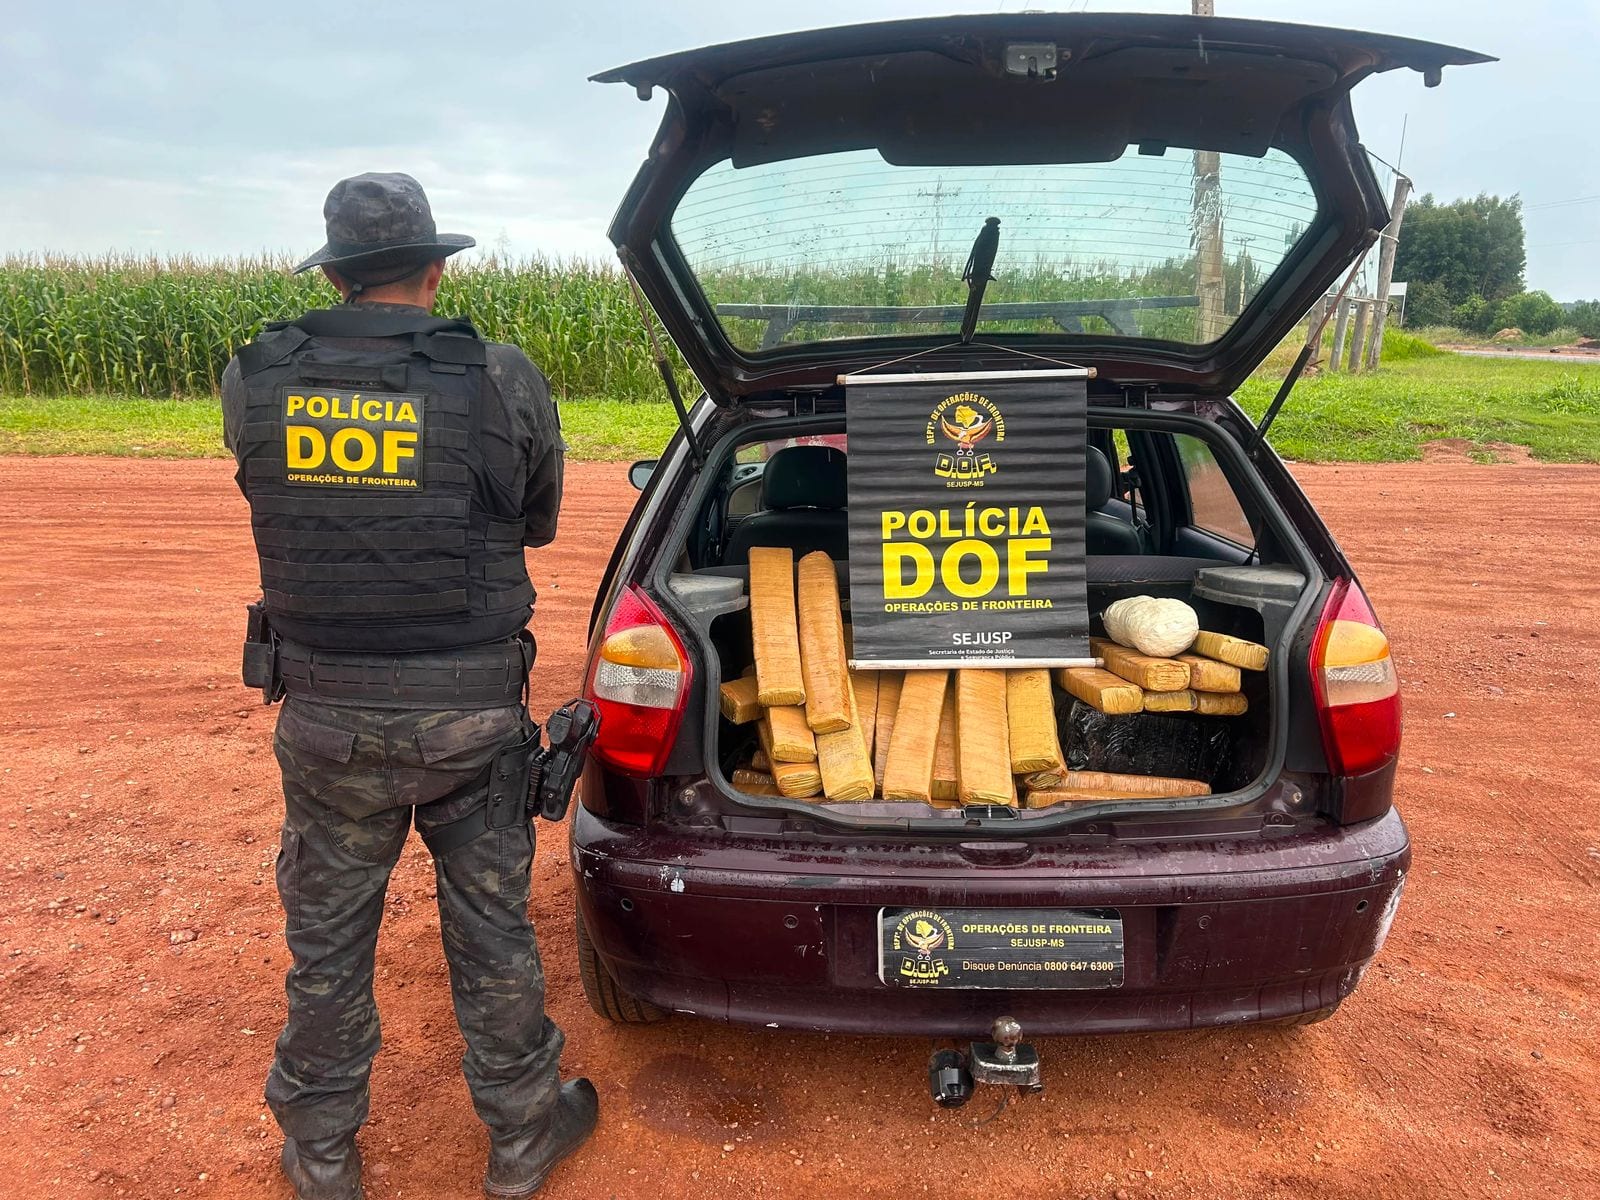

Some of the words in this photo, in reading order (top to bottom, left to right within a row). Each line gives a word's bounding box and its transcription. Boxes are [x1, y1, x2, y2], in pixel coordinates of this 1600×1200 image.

[286, 394, 418, 423] POLÍCIA
[930, 408, 941, 421] DE
[939, 392, 979, 411] OPERAÇÕES
[979, 396, 989, 408] DE
[986, 402, 1005, 442] FRONTEIRA
[286, 425, 418, 474] DOF
[934, 453, 997, 479] D.O.F.
[287, 473, 344, 484] OPERAÇÕES
[346, 476, 359, 484] DE
[361, 476, 418, 487] FRONTEIRA
[946, 480, 985, 488] SEJUSP-MS
[881, 502, 1052, 539] POLÍCIA
[882, 537, 1052, 599] DOF
[884, 601, 959, 613] OPERAÇÕES
[962, 601, 979, 611] DE
[981, 599, 1053, 610] FRONTEIRA
[952, 631, 1012, 645] SEJUSP
[902, 910, 933, 925] OPERAÇÕES
[939, 918, 955, 950] FRONTEIRA
[962, 923, 1028, 935] OPERAÇÕES
[1031, 924, 1046, 934] DE
[1049, 924, 1112, 934] FRONTEIRA
[1010, 938, 1065, 948] SEJUSP-MS
[962, 961, 995, 972] Disque
[997, 961, 1041, 971] Denúncia
[1044, 961, 1067, 971] 0800
[1070, 961, 1087, 971] 647
[1090, 961, 1114, 971] 6300
